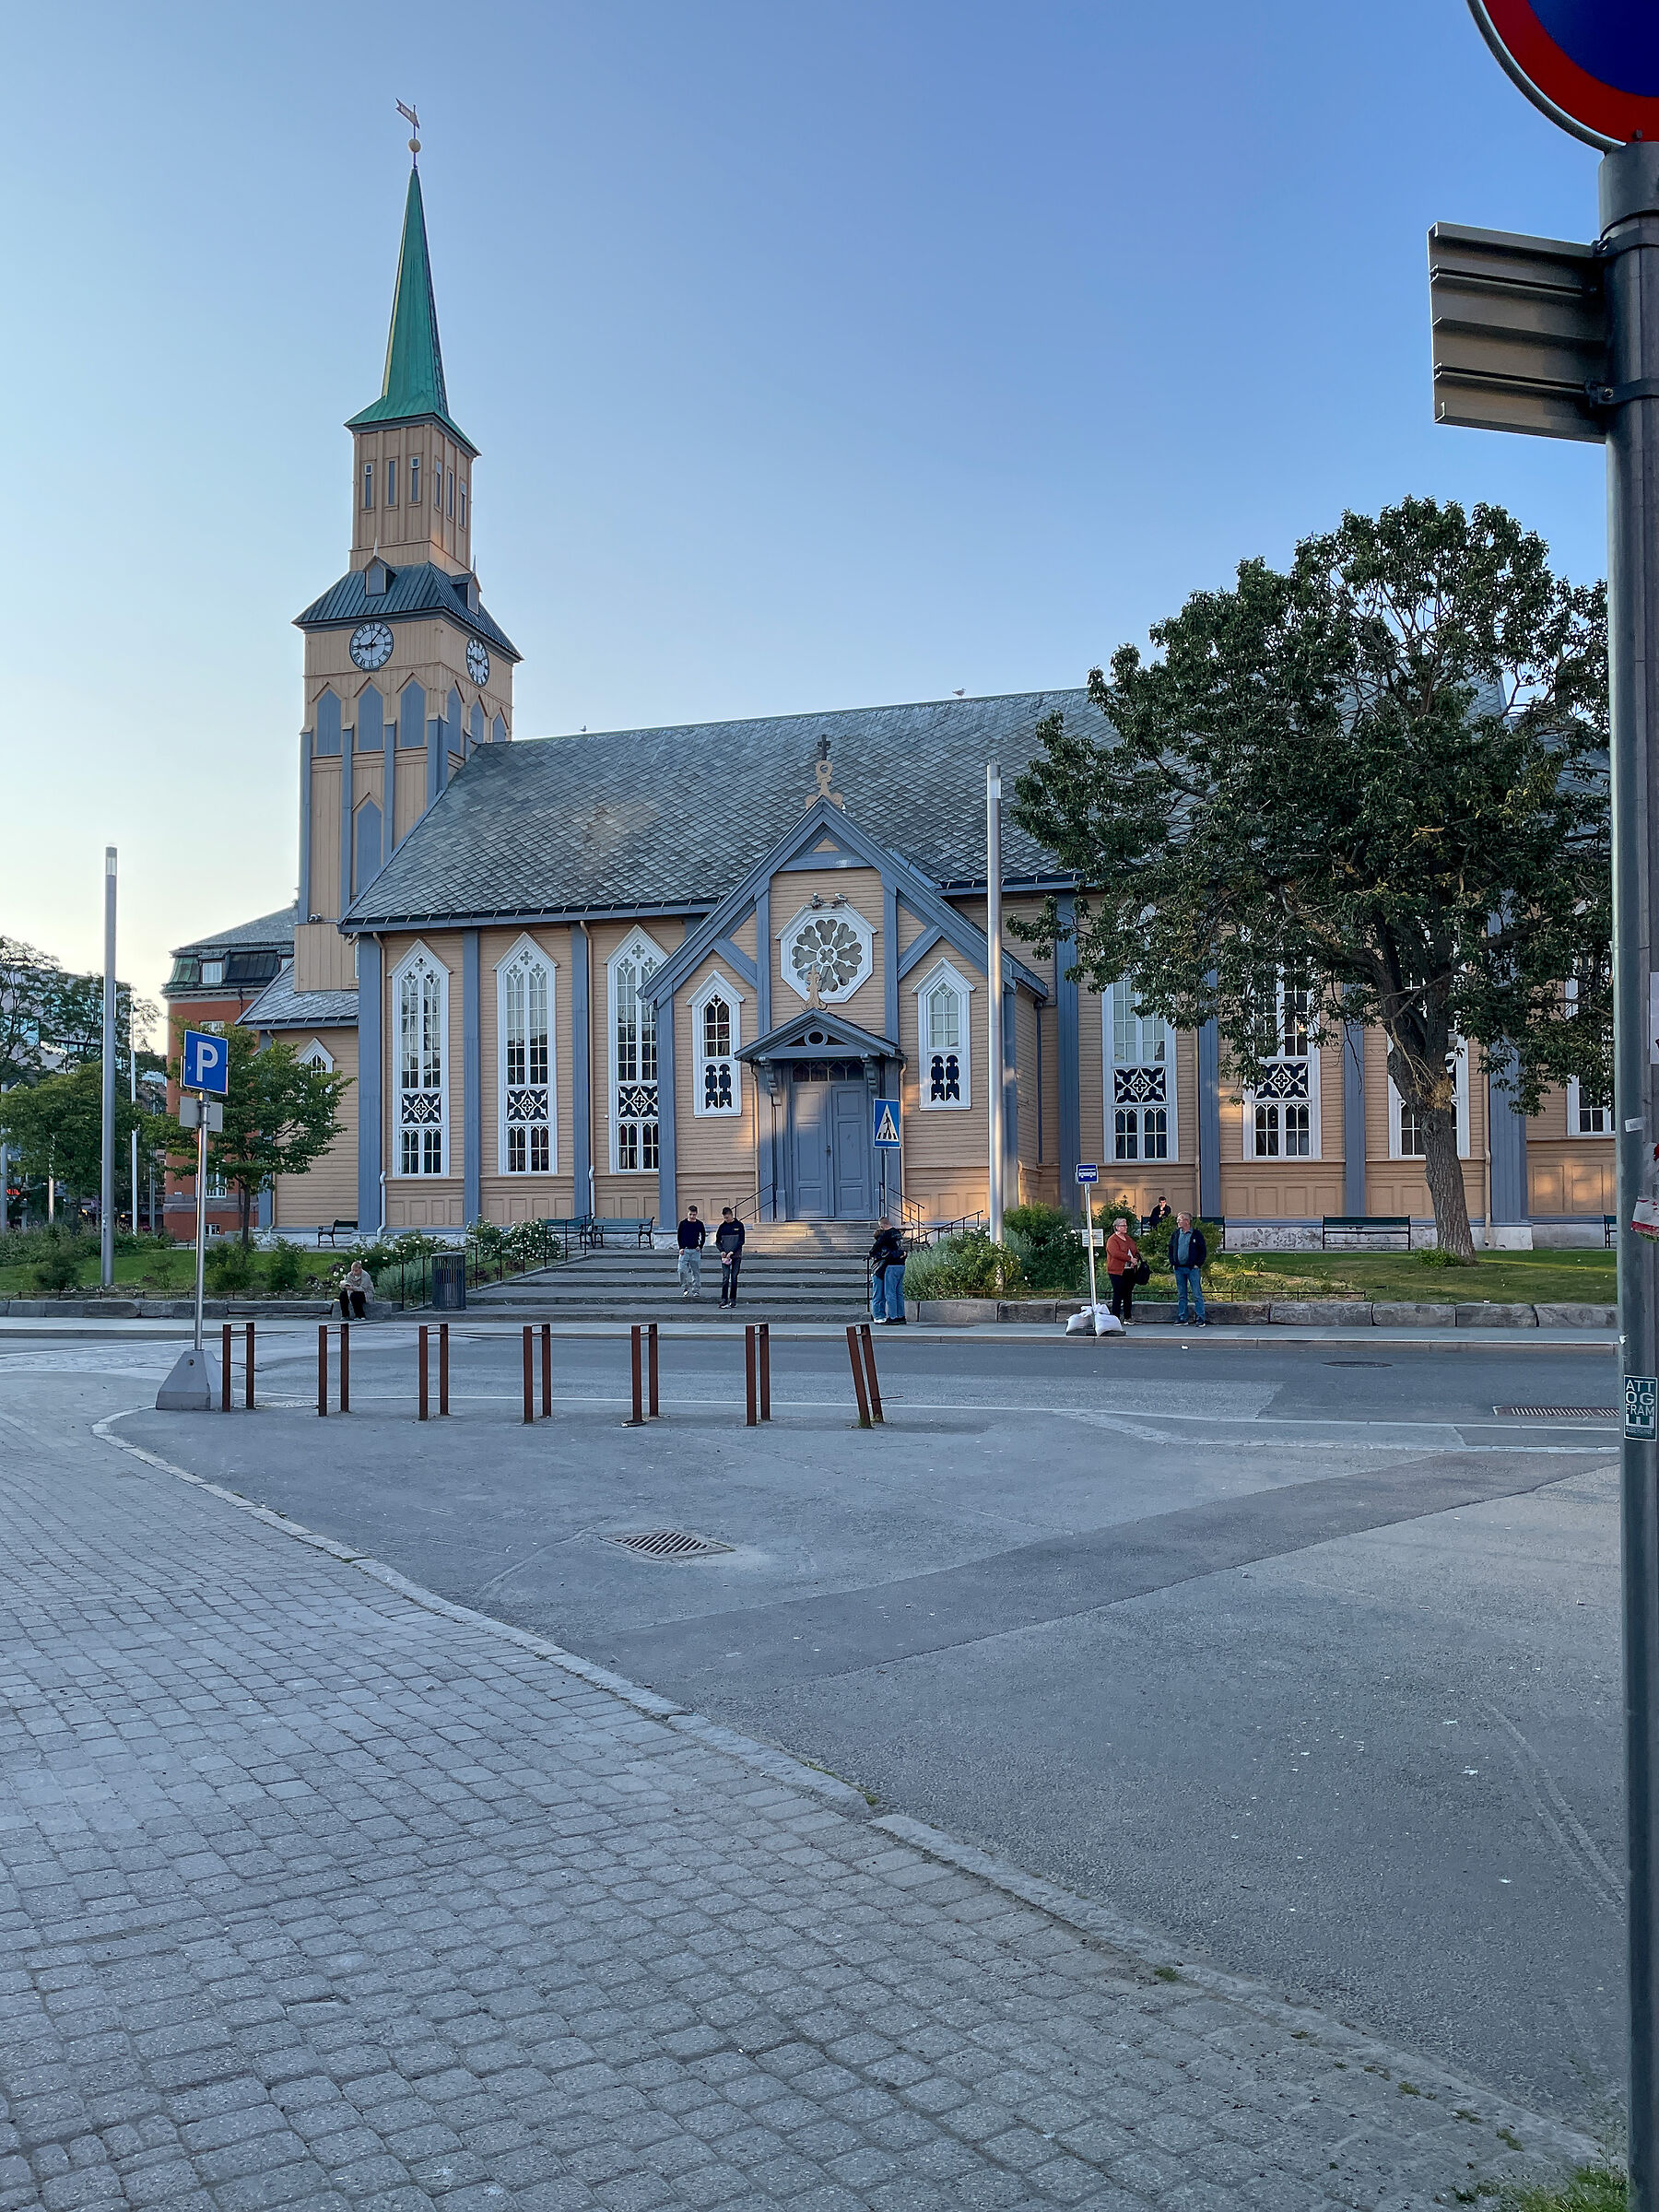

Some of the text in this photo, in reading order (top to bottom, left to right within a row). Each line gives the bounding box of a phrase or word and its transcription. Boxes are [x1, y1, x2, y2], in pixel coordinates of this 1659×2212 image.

[196, 1041, 218, 1082] P
[1626, 1379, 1654, 1392] ATT
[1625, 1391, 1654, 1406] OG
[1625, 1403, 1654, 1417] FRAM
